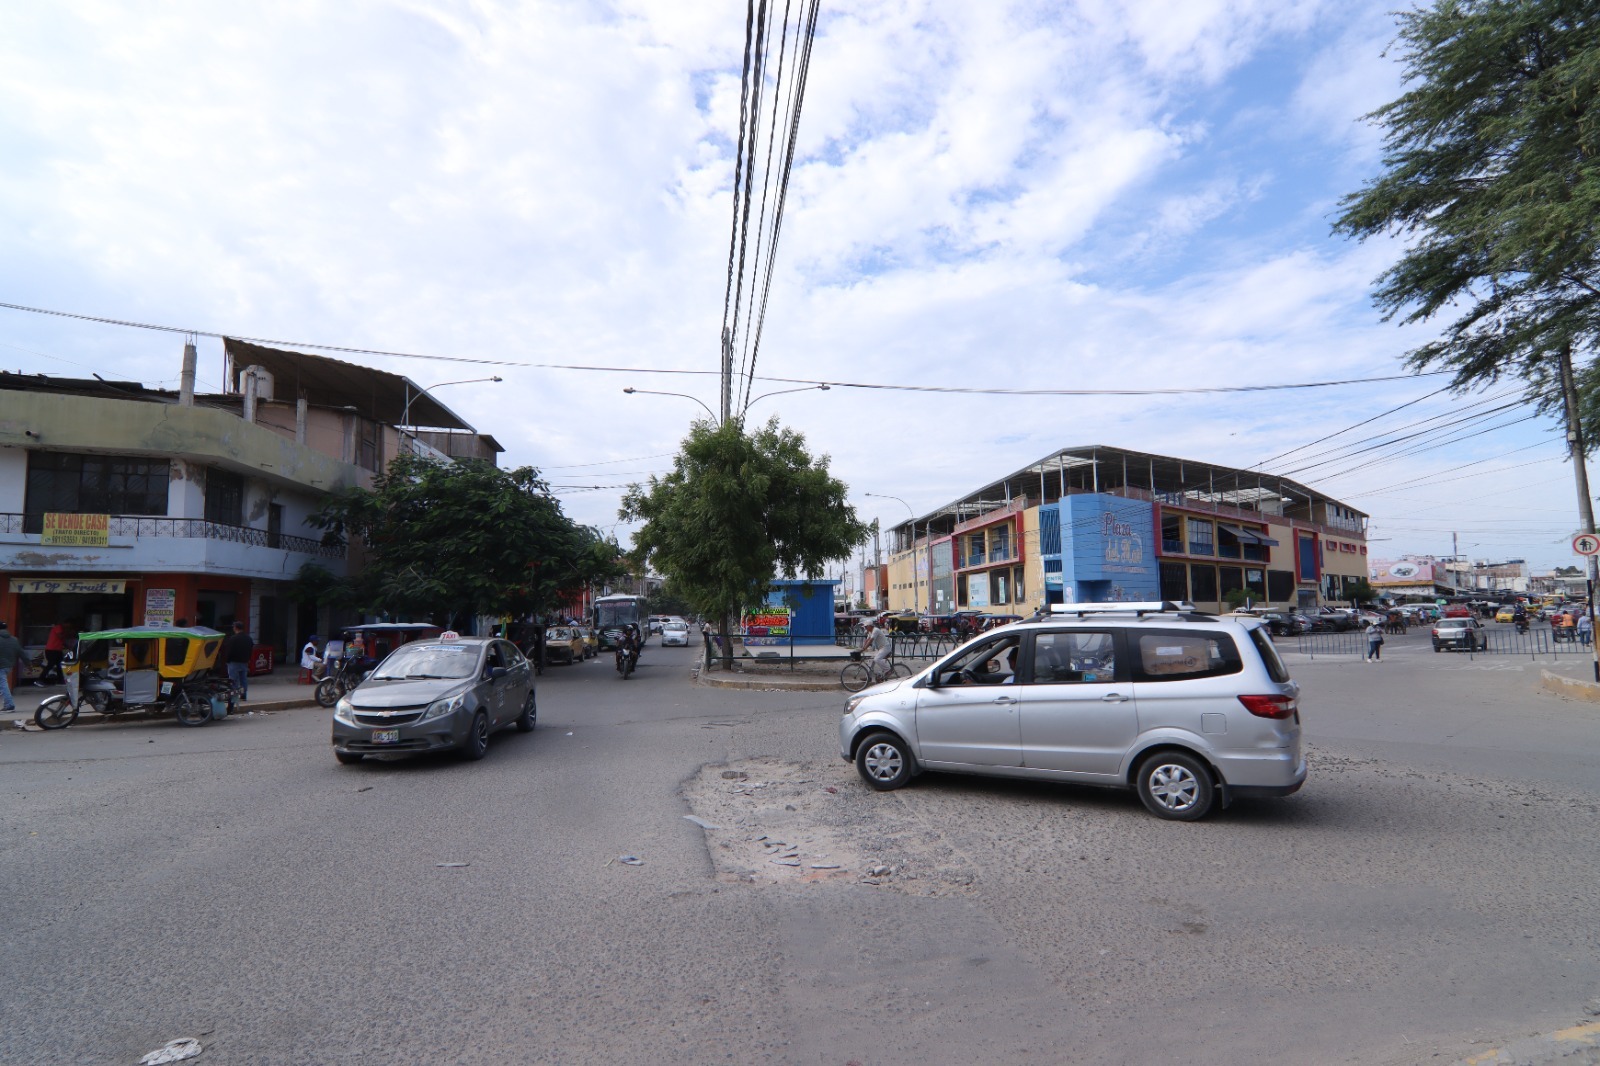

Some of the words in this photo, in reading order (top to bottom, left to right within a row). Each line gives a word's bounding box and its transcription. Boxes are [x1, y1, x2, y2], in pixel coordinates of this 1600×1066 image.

[46, 513, 56, 529] SE
[58, 513, 83, 530] VENDE
[86, 514, 108, 531] CASA
[1103, 511, 1132, 536] Plaza
[31, 581, 60, 593] Top
[67, 582, 107, 592] Fruit
